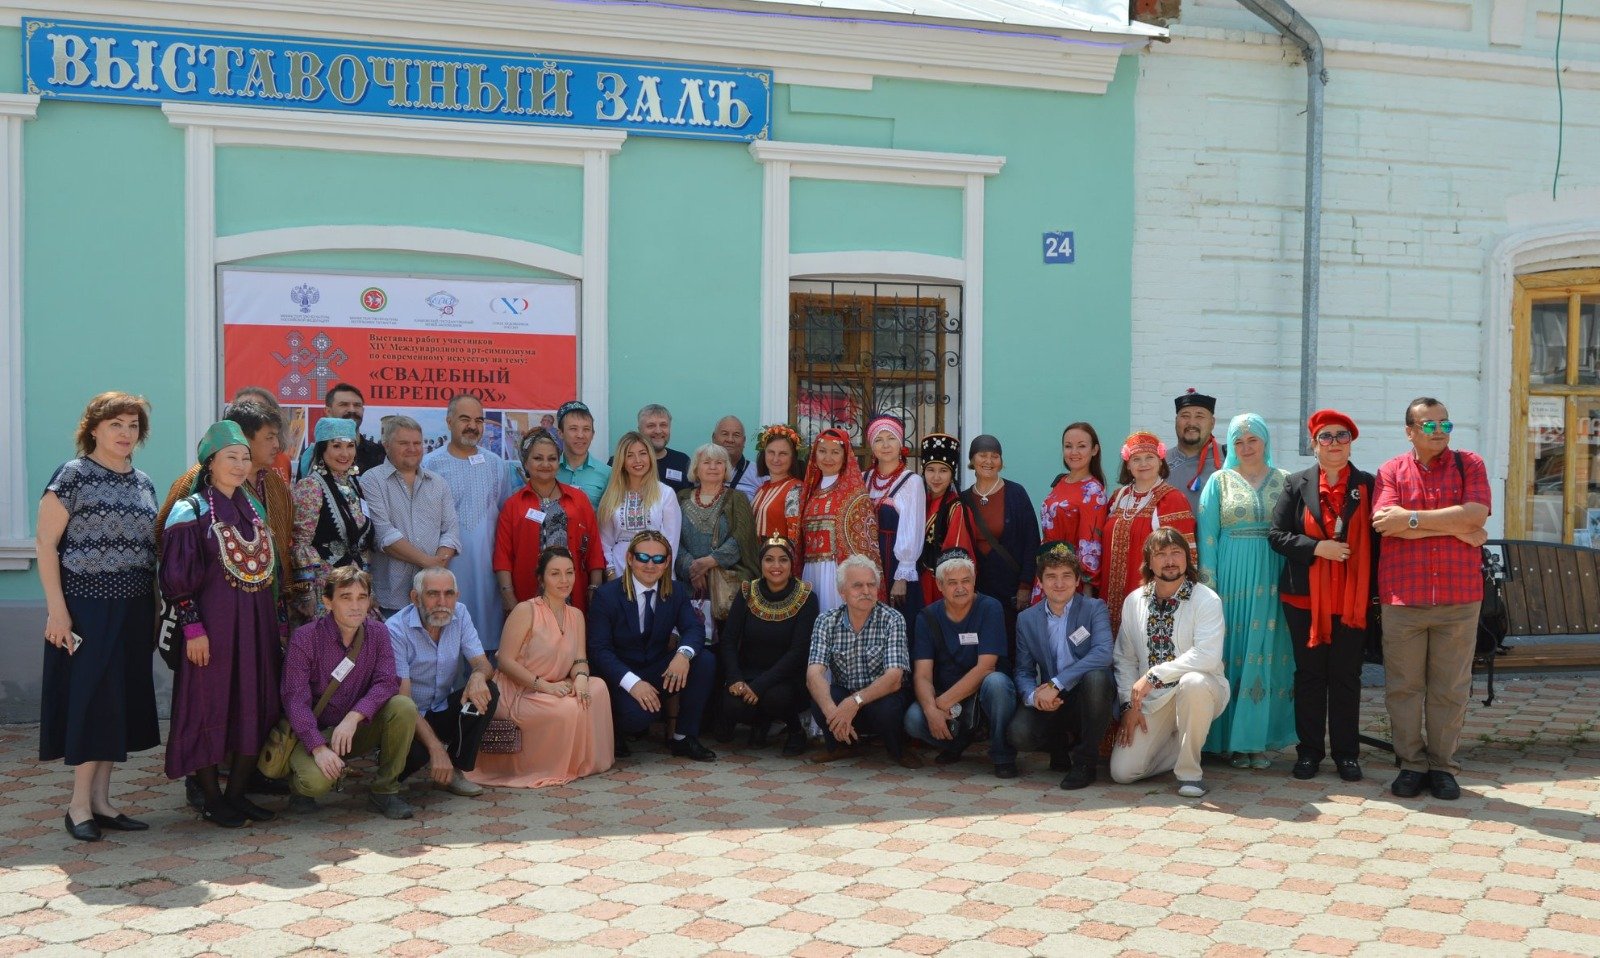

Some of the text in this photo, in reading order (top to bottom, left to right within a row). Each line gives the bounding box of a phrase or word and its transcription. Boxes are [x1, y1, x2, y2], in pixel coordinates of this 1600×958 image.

[47, 33, 752, 129] ВЫСТАВОЧНЫЙ ЗАЛЪ
[1045, 237, 1072, 257] 24
[369, 333, 493, 345] Выставка работ участников
[369, 342, 536, 356] XIV Международного арт-симпозиума
[382, 353, 444, 362] современному
[447, 355, 489, 364] искусству
[369, 366, 510, 384] «СВАДЕБНЫЙ
